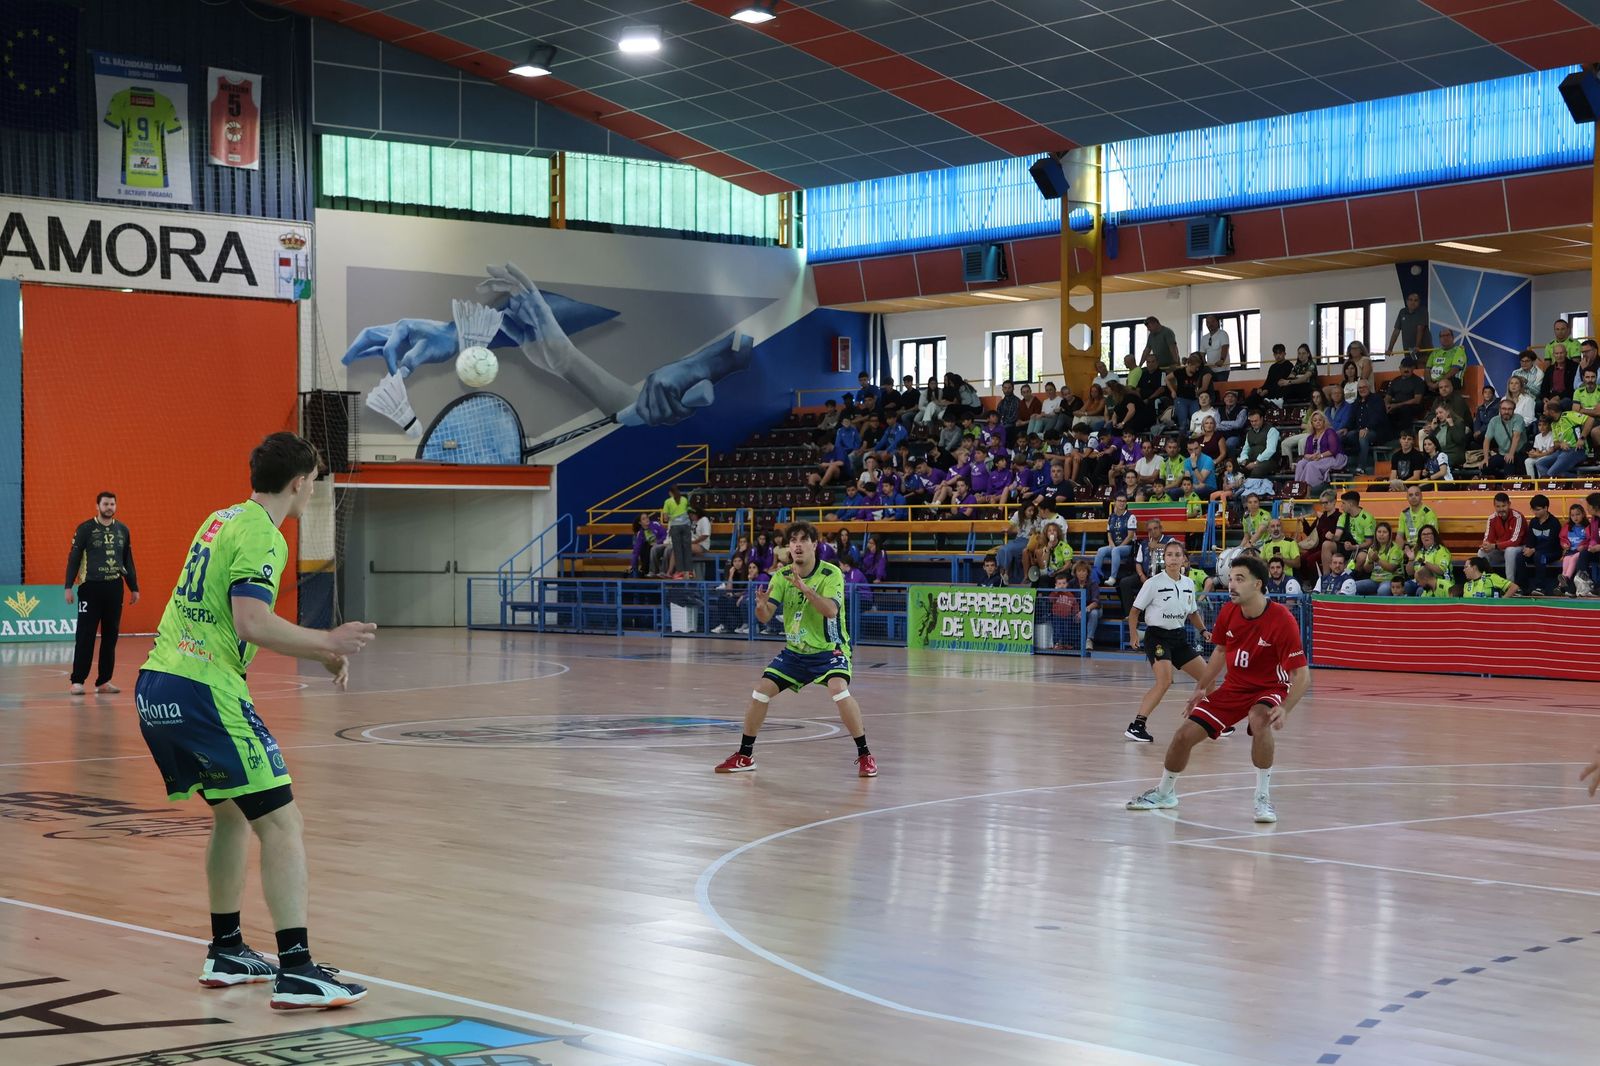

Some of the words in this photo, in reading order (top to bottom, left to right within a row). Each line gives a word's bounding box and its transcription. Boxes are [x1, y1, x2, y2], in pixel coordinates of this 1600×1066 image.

[228, 93, 241, 117] 5
[137, 117, 149, 141] 9
[0, 212, 259, 287] AMORA
[104, 533, 115, 544] 12
[78, 601, 88, 612] 12
[937, 591, 1034, 615] GUERREROS
[941, 617, 963, 639] DE
[970, 618, 1033, 640] VIRIATO
[1234, 648, 1250, 668] 18
